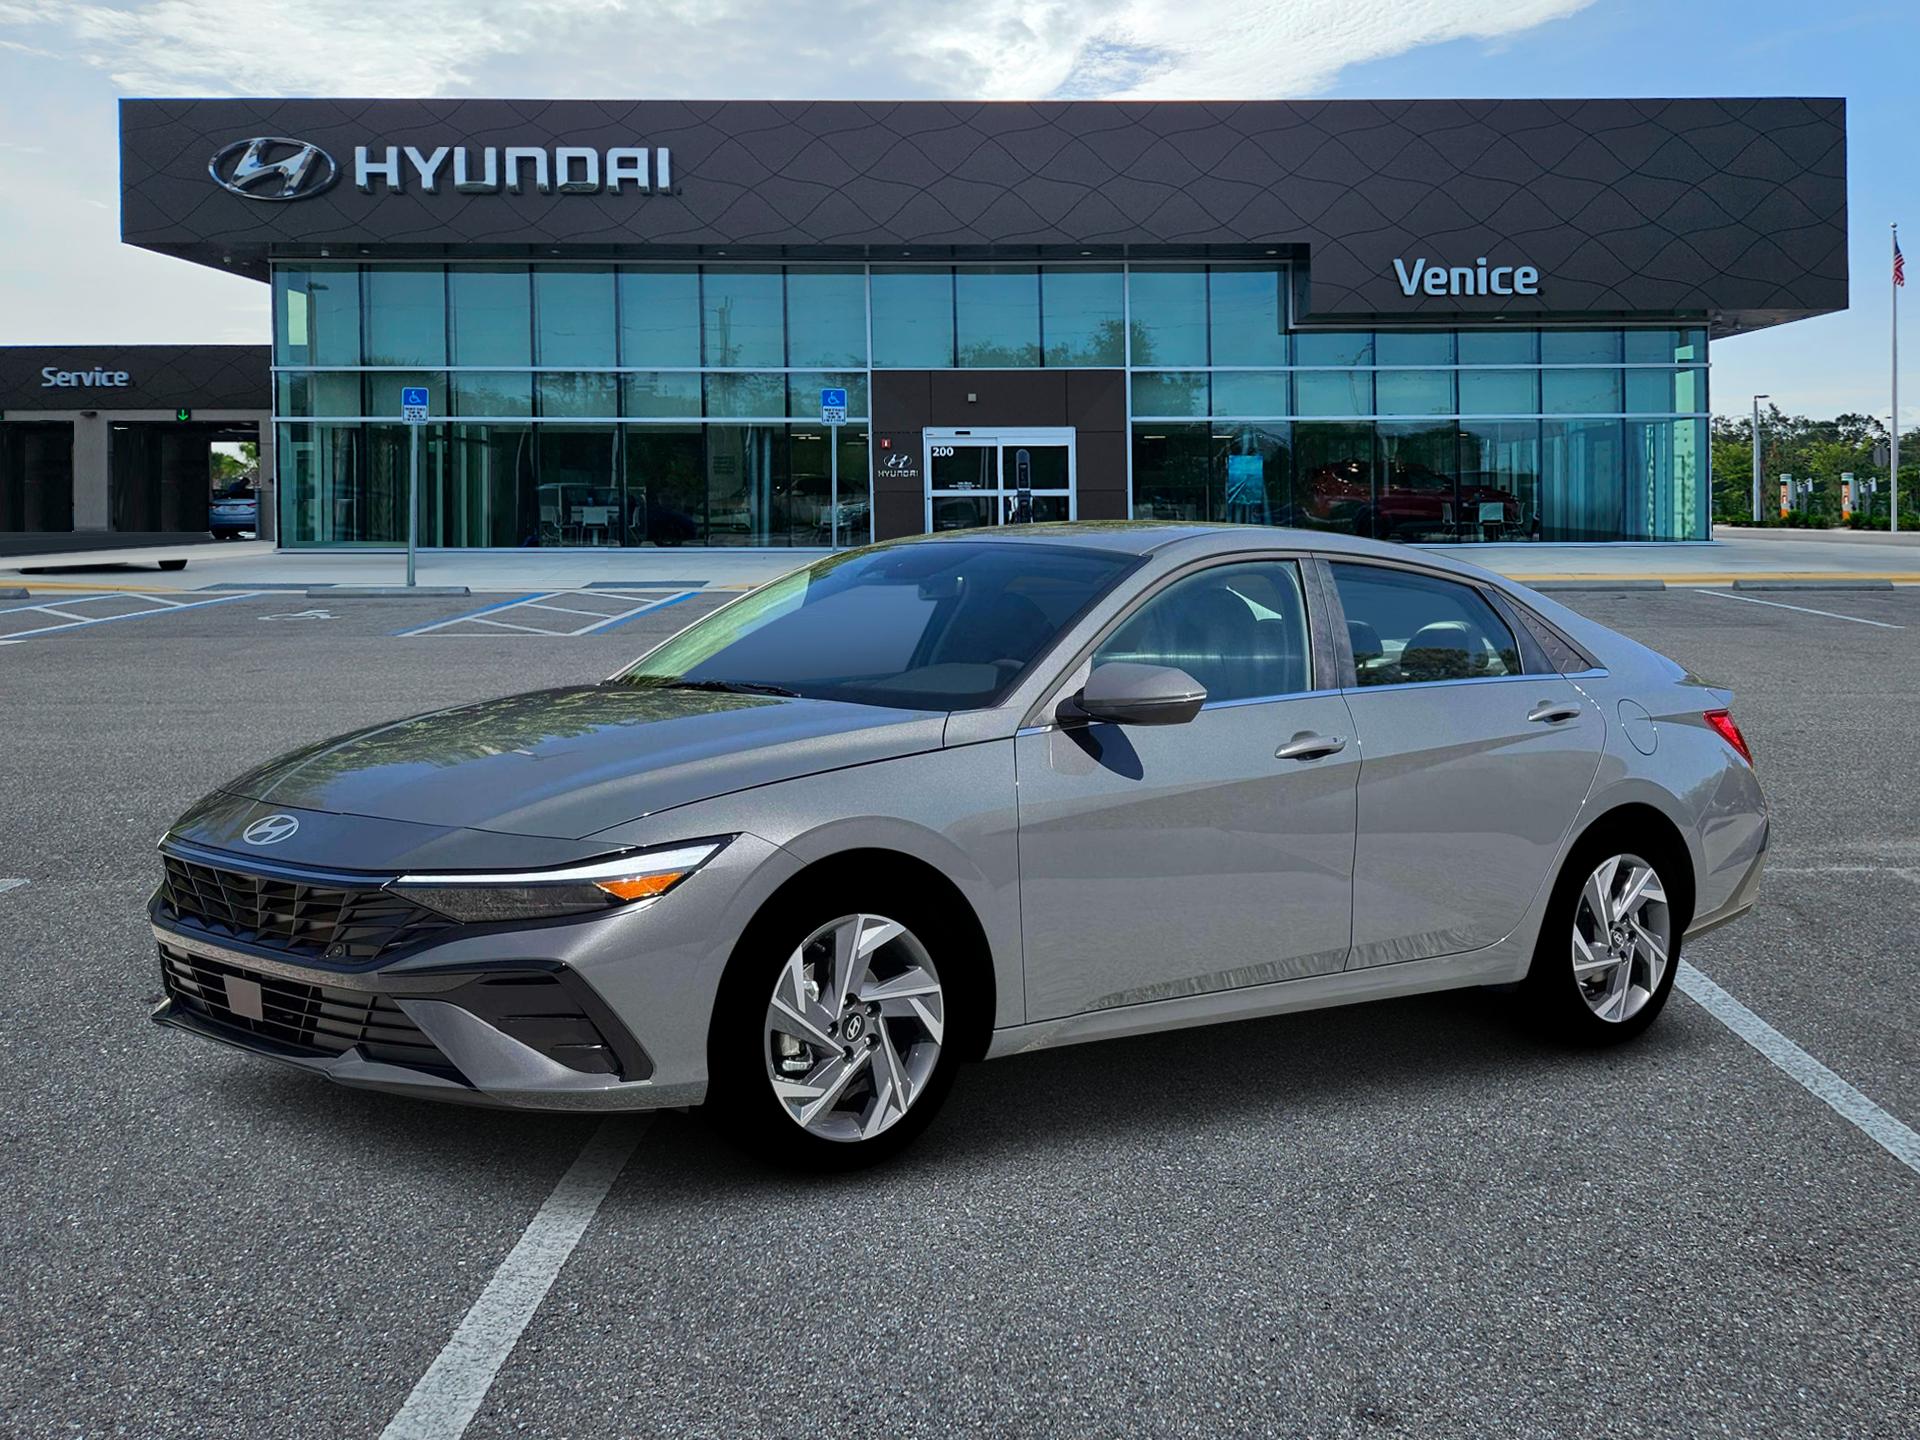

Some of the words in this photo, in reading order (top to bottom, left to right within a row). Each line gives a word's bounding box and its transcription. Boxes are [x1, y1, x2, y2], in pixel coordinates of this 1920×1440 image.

[354, 146, 673, 195] HYUNDAI
[1393, 256, 1539, 296] Venice
[40, 366, 130, 388] Service
[932, 446, 954, 457] 200
[877, 469, 919, 478] HYUNDAI
